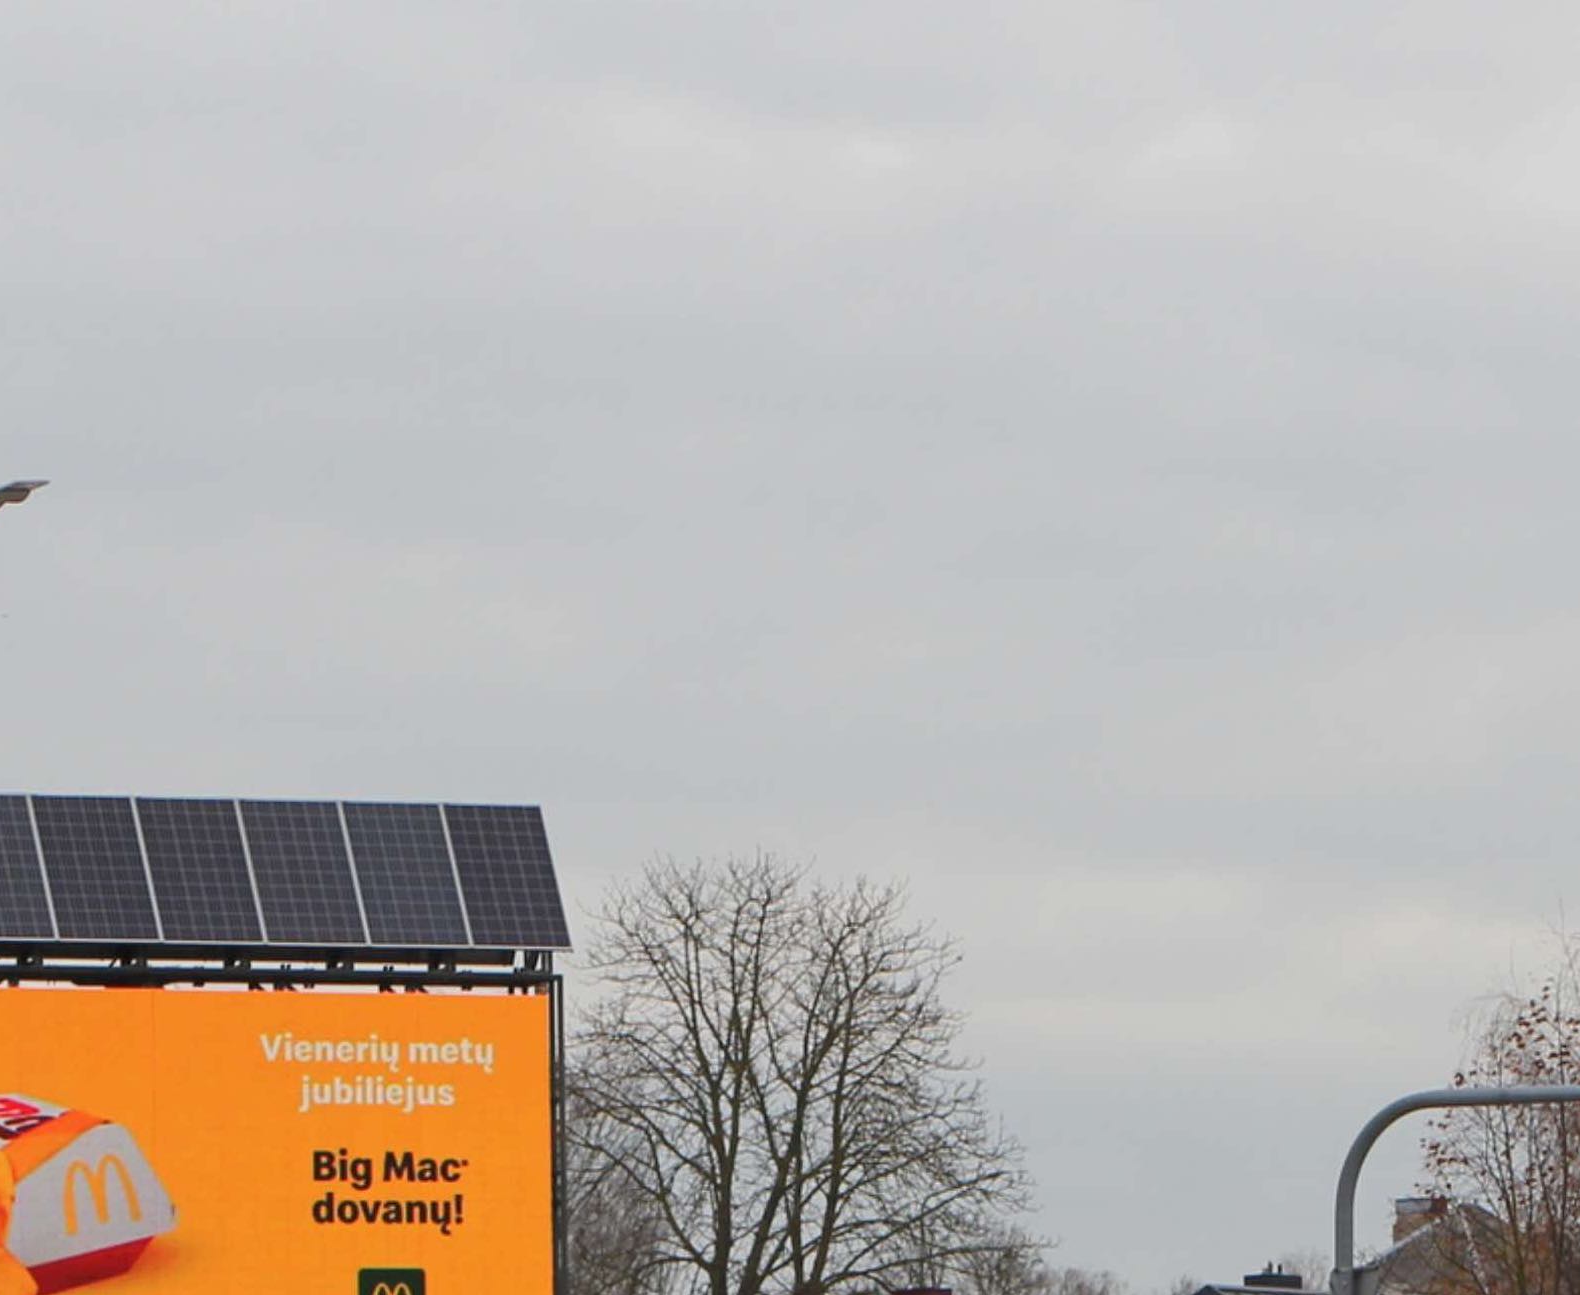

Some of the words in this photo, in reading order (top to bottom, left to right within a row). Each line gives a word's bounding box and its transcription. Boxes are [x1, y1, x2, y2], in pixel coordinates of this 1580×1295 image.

[260, 1032, 400, 1073] Vienerių
[409, 1037, 495, 1074] metų
[298, 1075, 456, 1114] jubiliejus
[313, 1148, 373, 1191] Big
[312, 1192, 464, 1236] dovanų!
